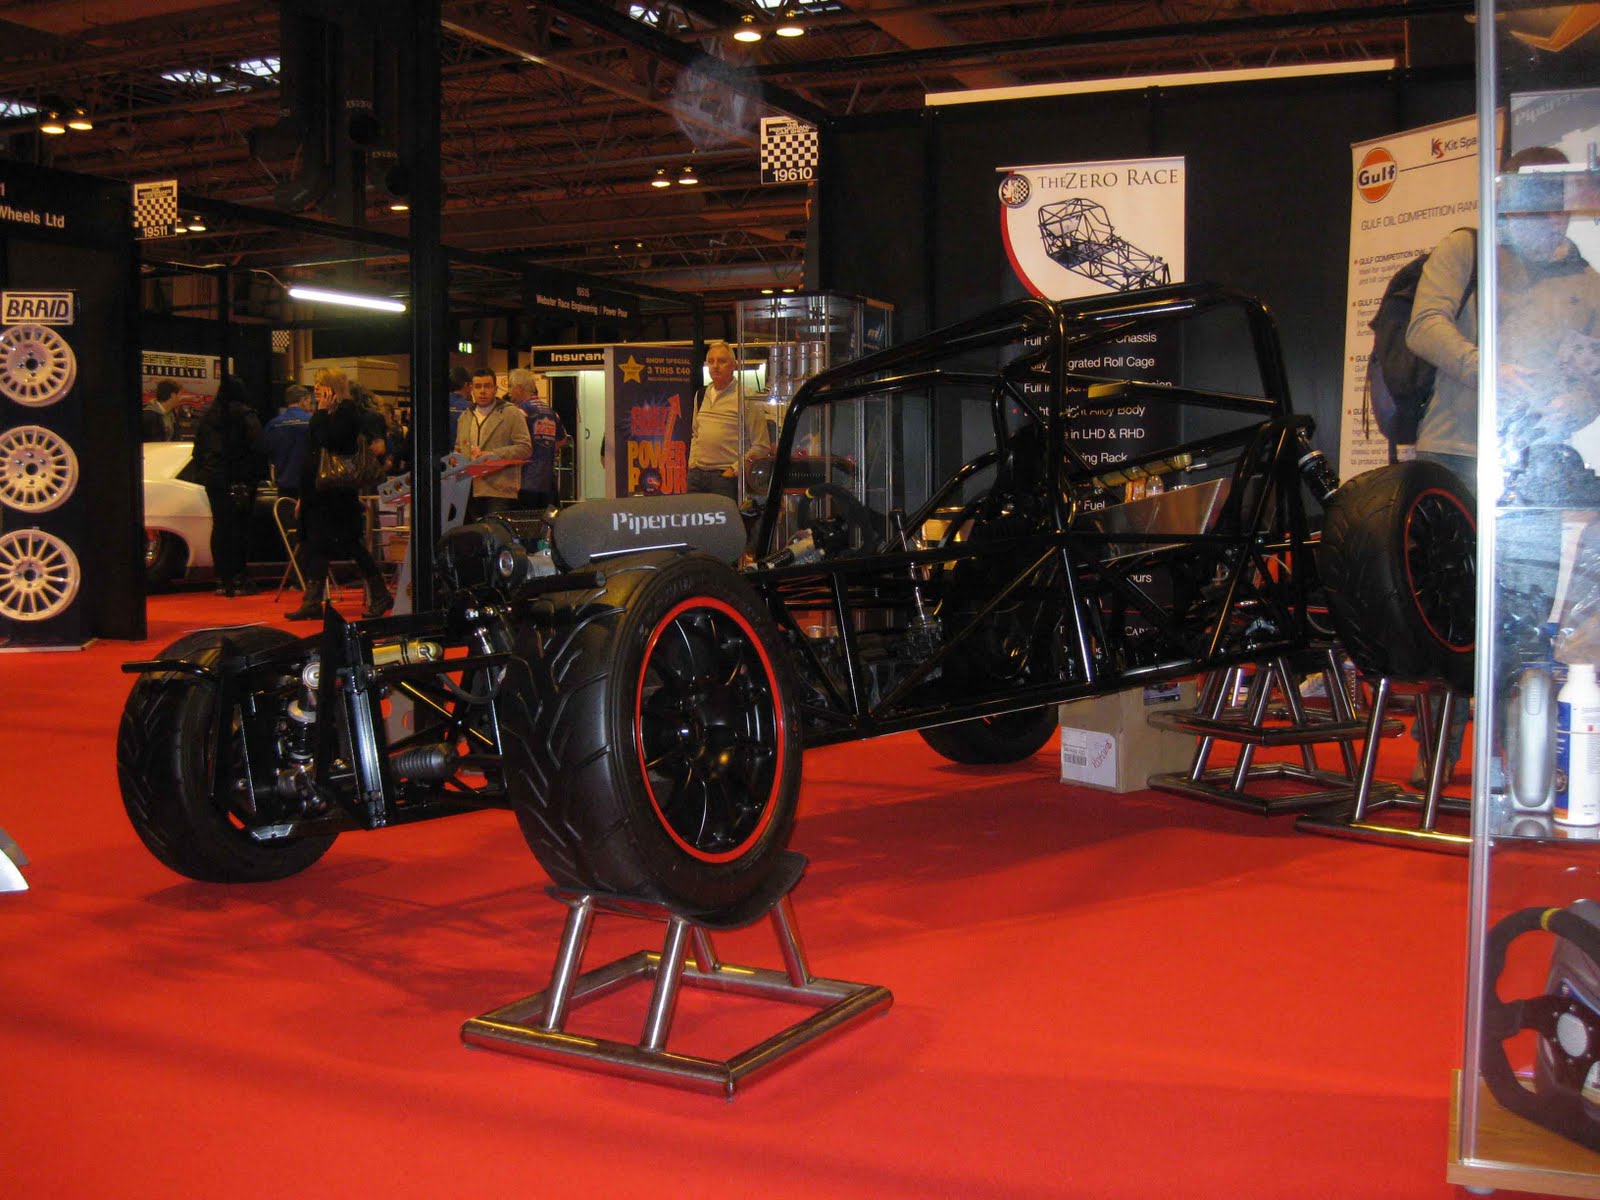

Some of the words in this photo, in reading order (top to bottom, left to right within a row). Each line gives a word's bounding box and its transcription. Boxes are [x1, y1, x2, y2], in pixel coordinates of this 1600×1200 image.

[1444, 140, 1459, 151] Kit
[1461, 136, 1477, 149] Spa
[773, 167, 813, 182] 19610
[1065, 172, 1118, 189] ZERO
[1127, 169, 1178, 186] RACE
[1358, 164, 1395, 187] Gulf
[0, 205, 40, 225] Wheels
[46, 213, 65, 228] Ltd
[1360, 216, 1382, 231] GULF
[1383, 214, 1397, 227] OIL
[1397, 204, 1456, 225] COMPETITION
[1457, 200, 1478, 215] RAN
[143, 225, 168, 237] 19511
[7, 299, 70, 317] BRAID
[647, 366, 652, 374] 3
[675, 367, 691, 375] £40
[1068, 358, 1100, 369] grated
[1104, 358, 1124, 367] Roll
[1126, 357, 1155, 369] Cage
[1024, 383, 1042, 393] Full
[1071, 429, 1079, 439] in
[1082, 429, 1106, 439] LHD
[1108, 429, 1117, 439] &
[1119, 428, 1145, 438] RHD
[1100, 452, 1128, 463] Rack
[1083, 500, 1106, 511] Fuel
[612, 511, 727, 535] Pipercross
